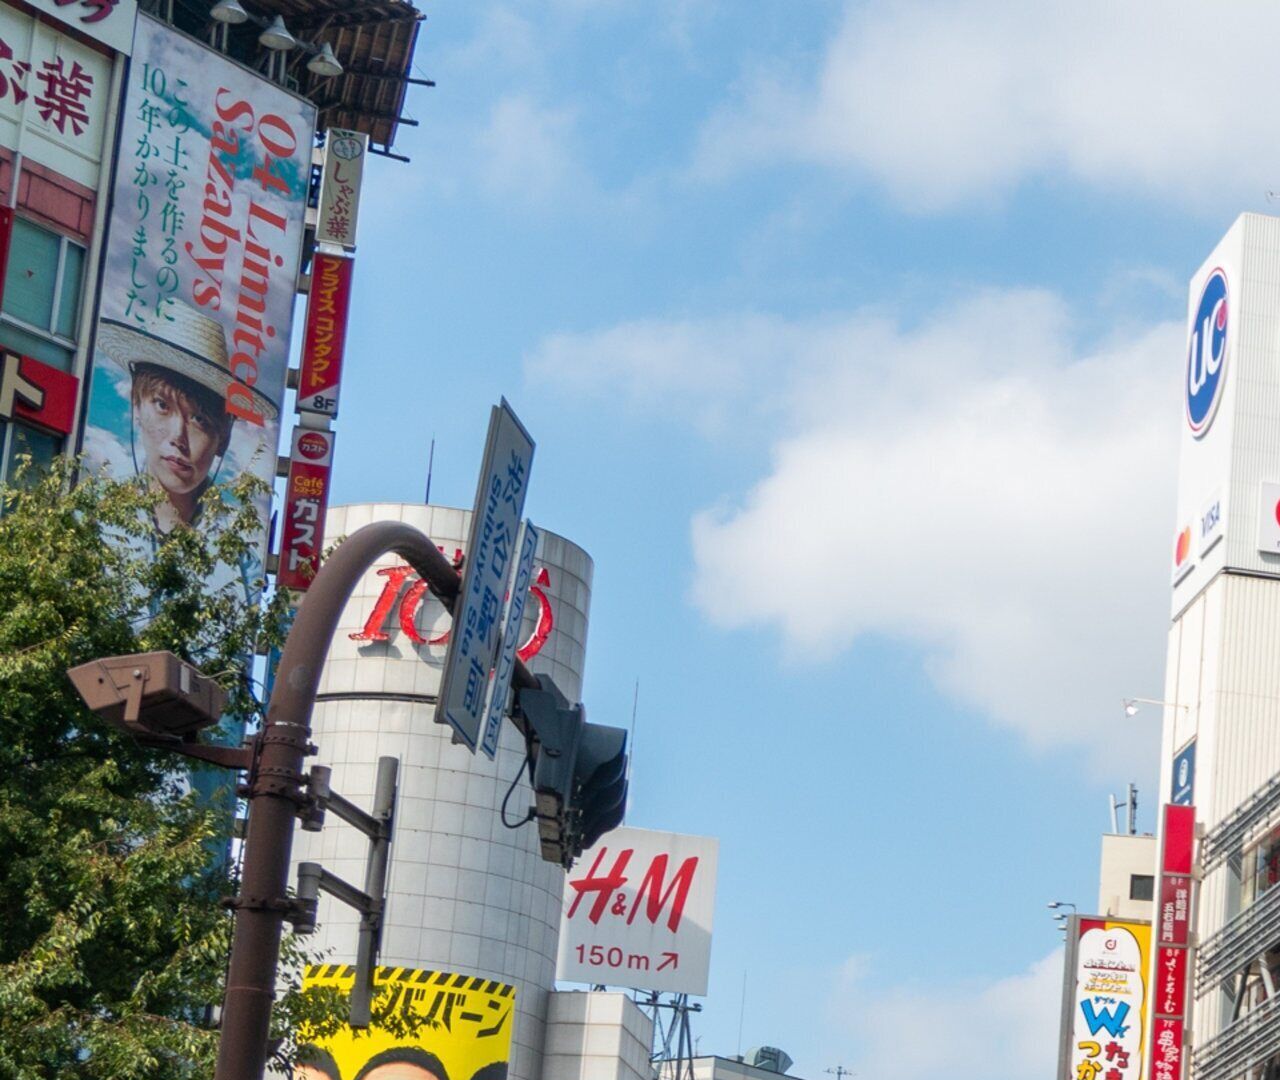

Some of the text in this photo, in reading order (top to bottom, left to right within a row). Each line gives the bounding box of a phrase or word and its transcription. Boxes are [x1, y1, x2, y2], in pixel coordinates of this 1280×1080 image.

[184, 86, 256, 312] Sazabys
[325, 160, 354, 240] しゃぶ葉
[224, 200, 290, 427] Limited
[313, 395, 336, 411] 8F
[294, 475, 324, 489] Café
[1200, 501, 1221, 538] VISA
[471, 472, 503, 597] Shibuya
[569, 846, 699, 934] H&M
[1162, 1019, 1176, 1029] 7F
